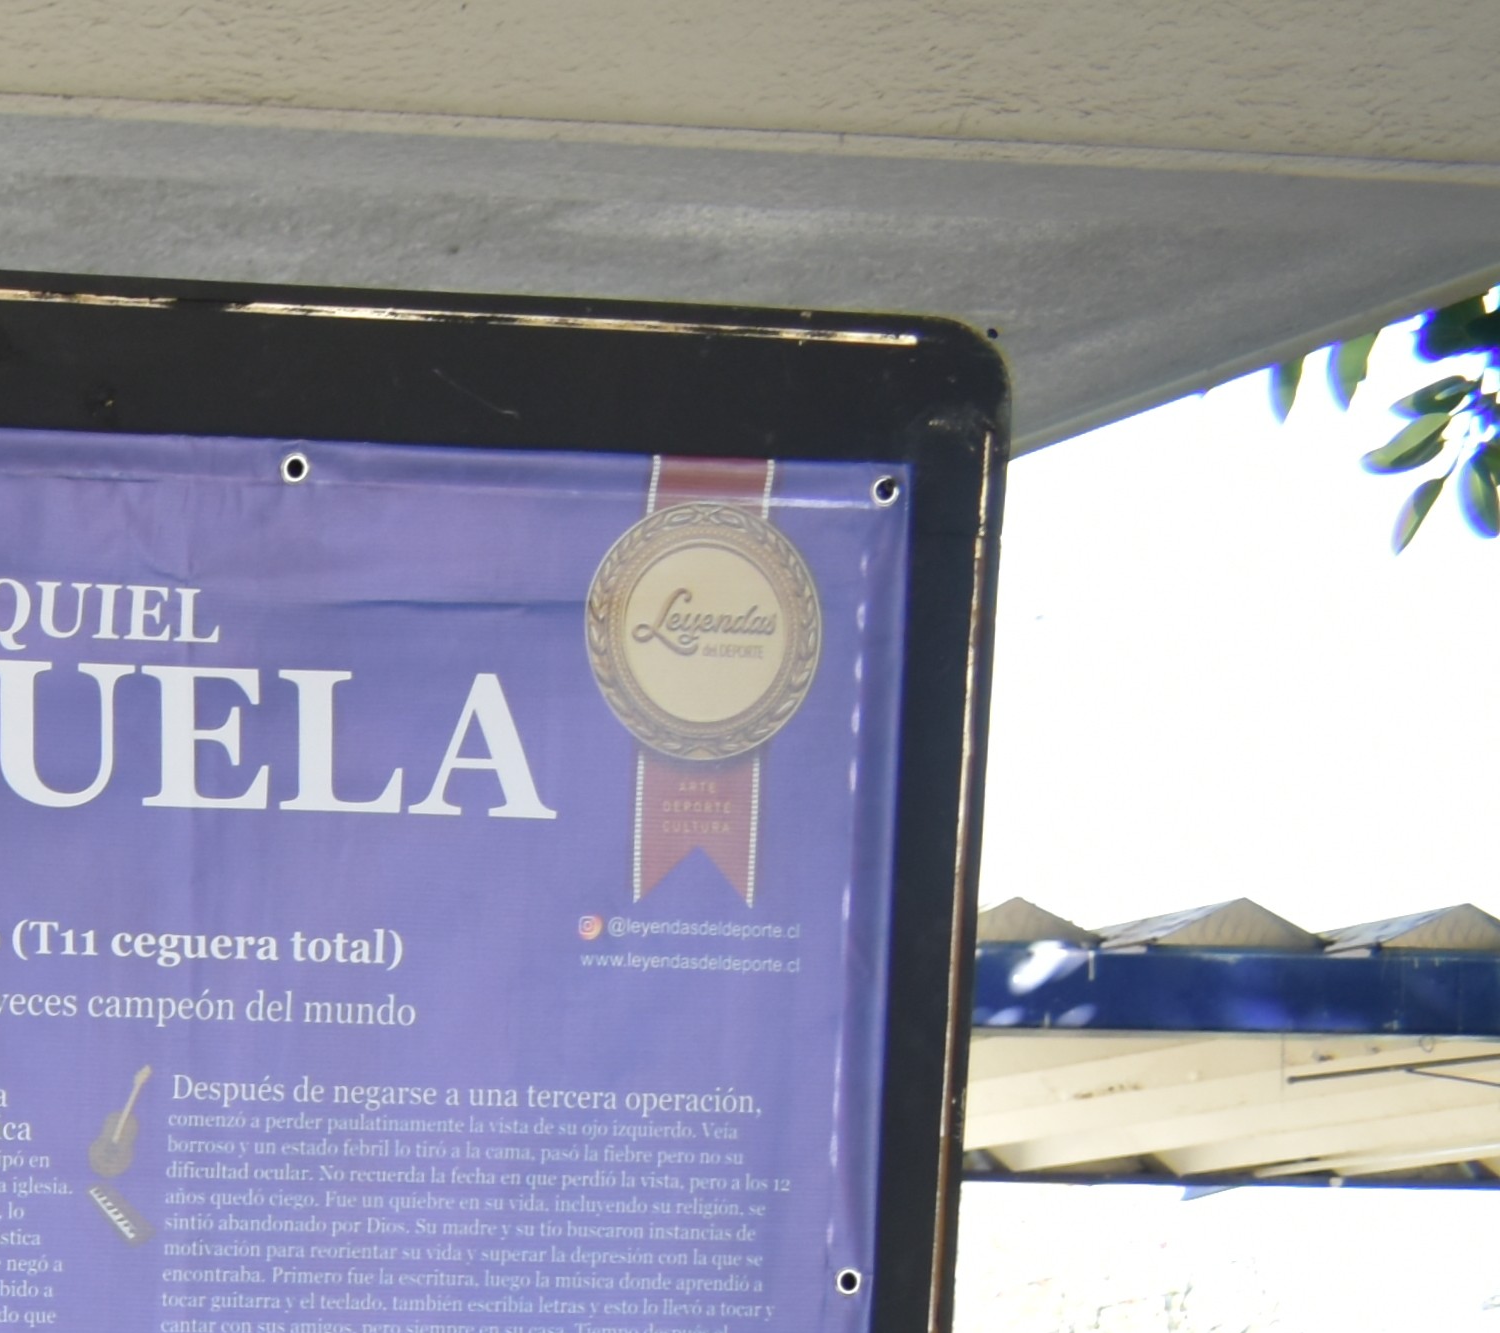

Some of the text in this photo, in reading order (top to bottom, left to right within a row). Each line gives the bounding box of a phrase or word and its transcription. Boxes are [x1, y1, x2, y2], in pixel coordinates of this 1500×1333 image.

[631, 587, 777, 656] Leyendas
[718, 643, 765, 661] DEPORTE
[677, 780, 718, 795] ARTE
[661, 799, 733, 815] DEPORTE
[661, 819, 733, 835] CULTURA
[606, 916, 801, 941] @leyendasdeldeporte.cl
[12, 919, 98, 961] (T11
[111, 932, 279, 967] ceguera
[290, 928, 403, 971] total)
[580, 950, 801, 974] www.leyendasdeldeporte.cl
[87, 988, 234, 1028] campeón
[245, 989, 292, 1023] del
[304, 993, 416, 1026] mundo
